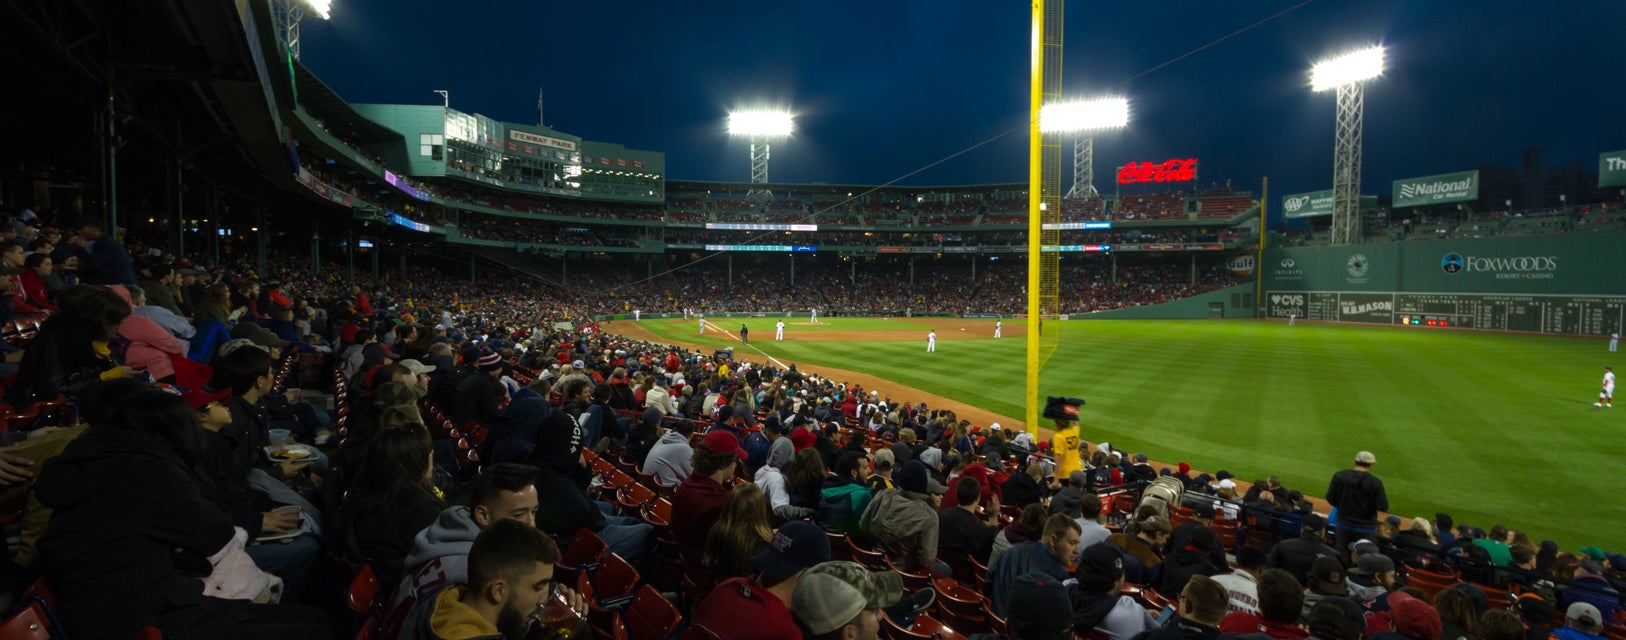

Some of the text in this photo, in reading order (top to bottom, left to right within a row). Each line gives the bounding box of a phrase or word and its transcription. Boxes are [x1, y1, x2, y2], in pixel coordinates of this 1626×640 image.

[513, 132, 572, 148] FENWAY PARK
[1415, 177, 1470, 195] National
[1228, 258, 1253, 270] Gulf
[1281, 294, 1304, 306] CVS
